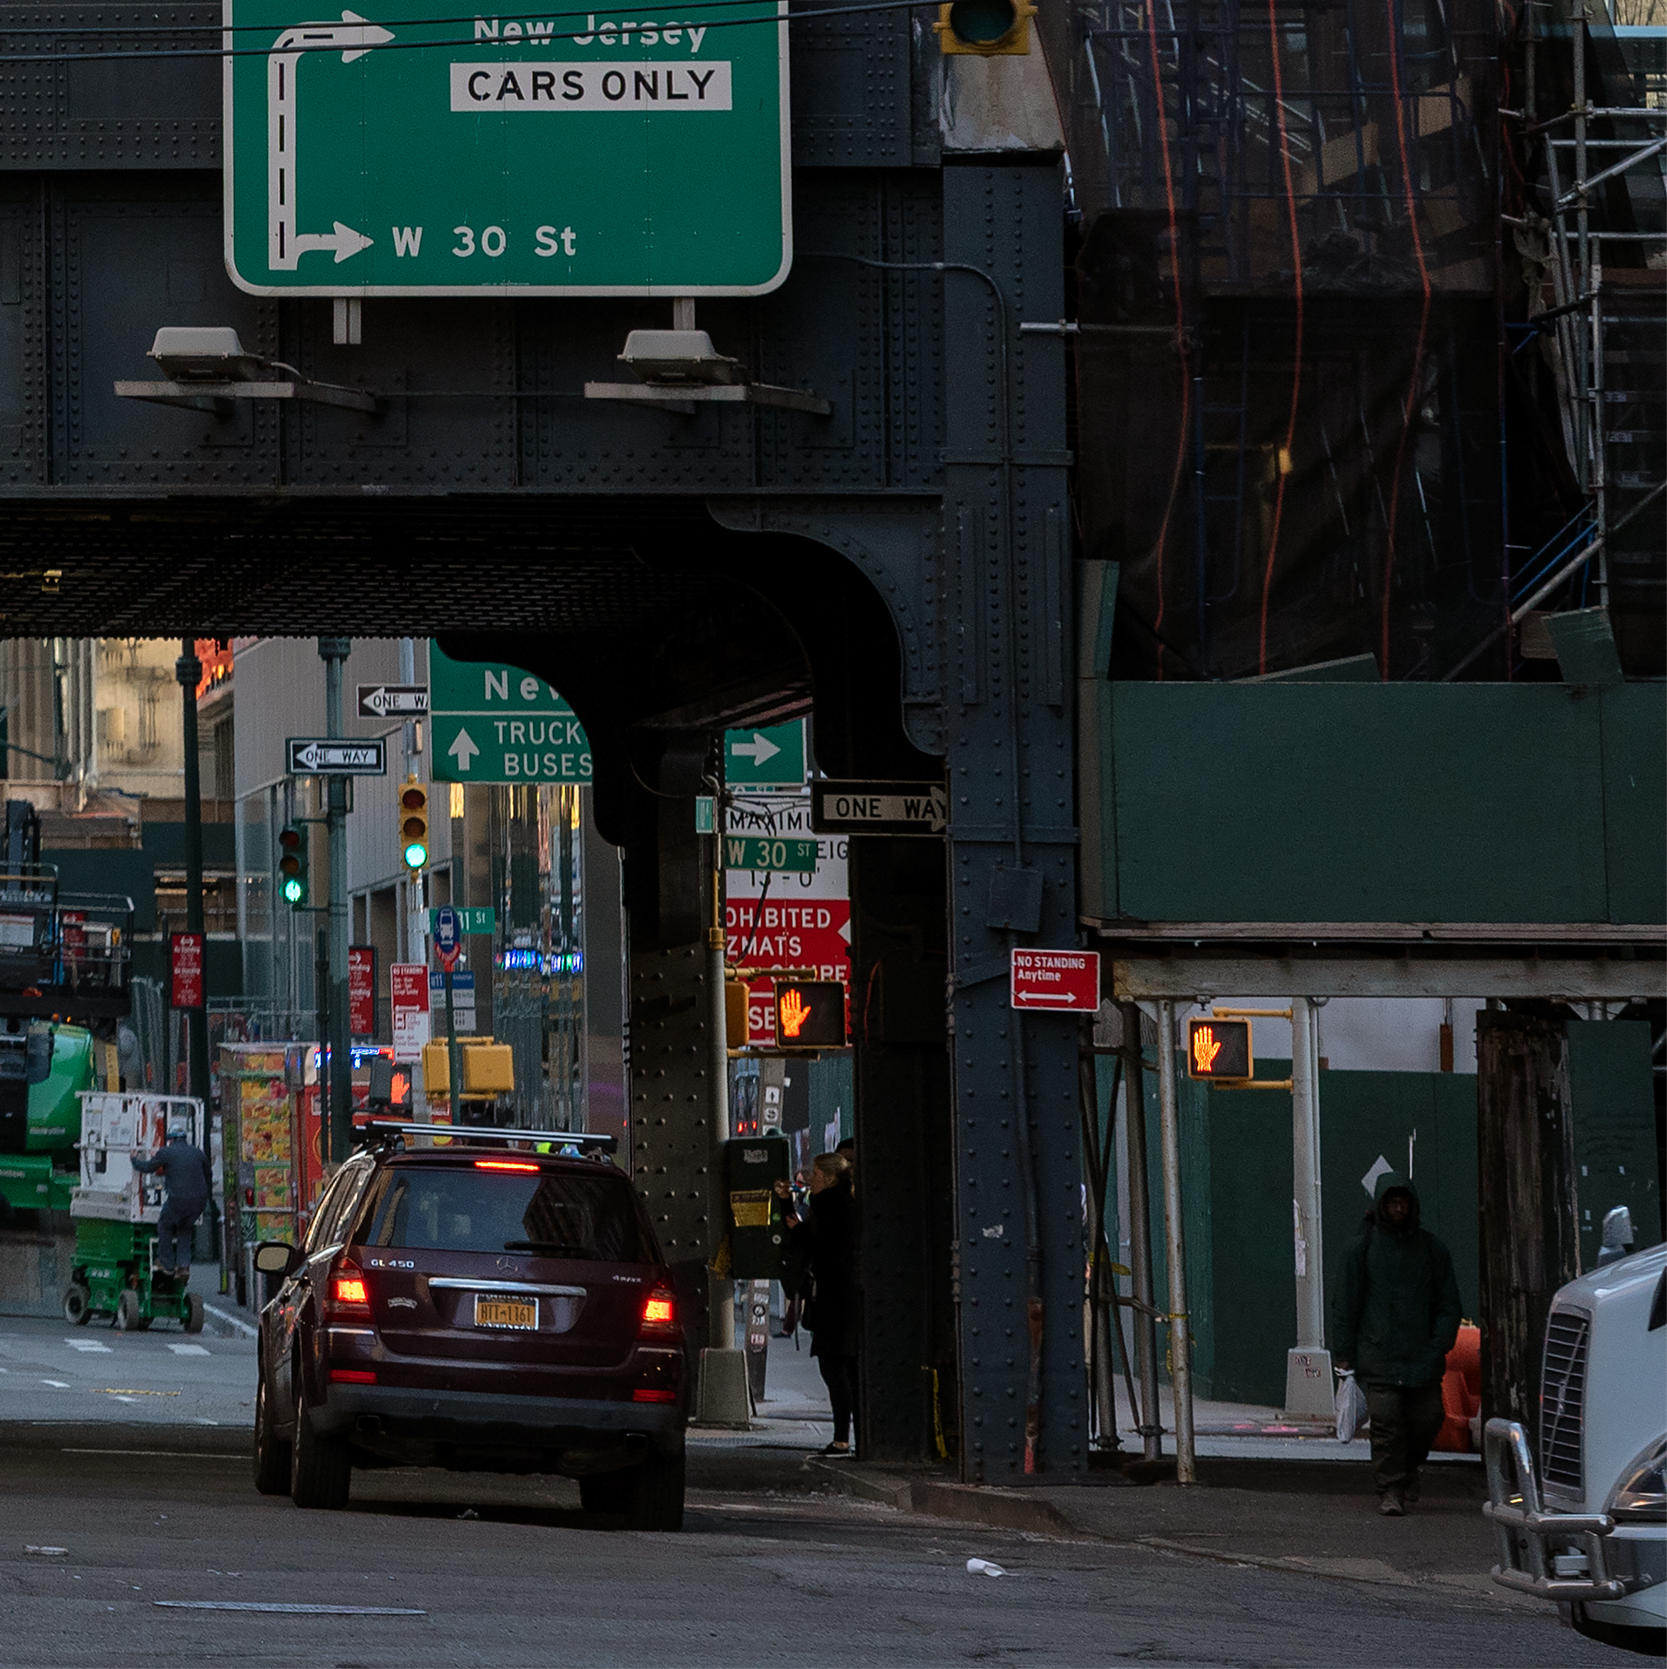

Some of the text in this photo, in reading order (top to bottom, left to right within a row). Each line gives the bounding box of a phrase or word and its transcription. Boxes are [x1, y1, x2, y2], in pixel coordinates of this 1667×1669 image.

[475, 14, 708, 53] New Jersey
[468, 69, 715, 101] CARS ONLY
[392, 224, 577, 258] W 30 St
[373, 693, 400, 708] ONE
[494, 721, 586, 745] TRUCK
[305, 749, 369, 762] ONE WAY
[504, 754, 593, 777] BUSES
[836, 797, 882, 819] ONE
[727, 839, 812, 868] W 30 ST
[726, 907, 831, 929] OHIBITED
[727, 935, 802, 957] ZMATS
[1017, 956, 1085, 970] NO STANDING
[1018, 969, 1061, 983] Anytime
[371, 1259, 414, 1269] GL 450
